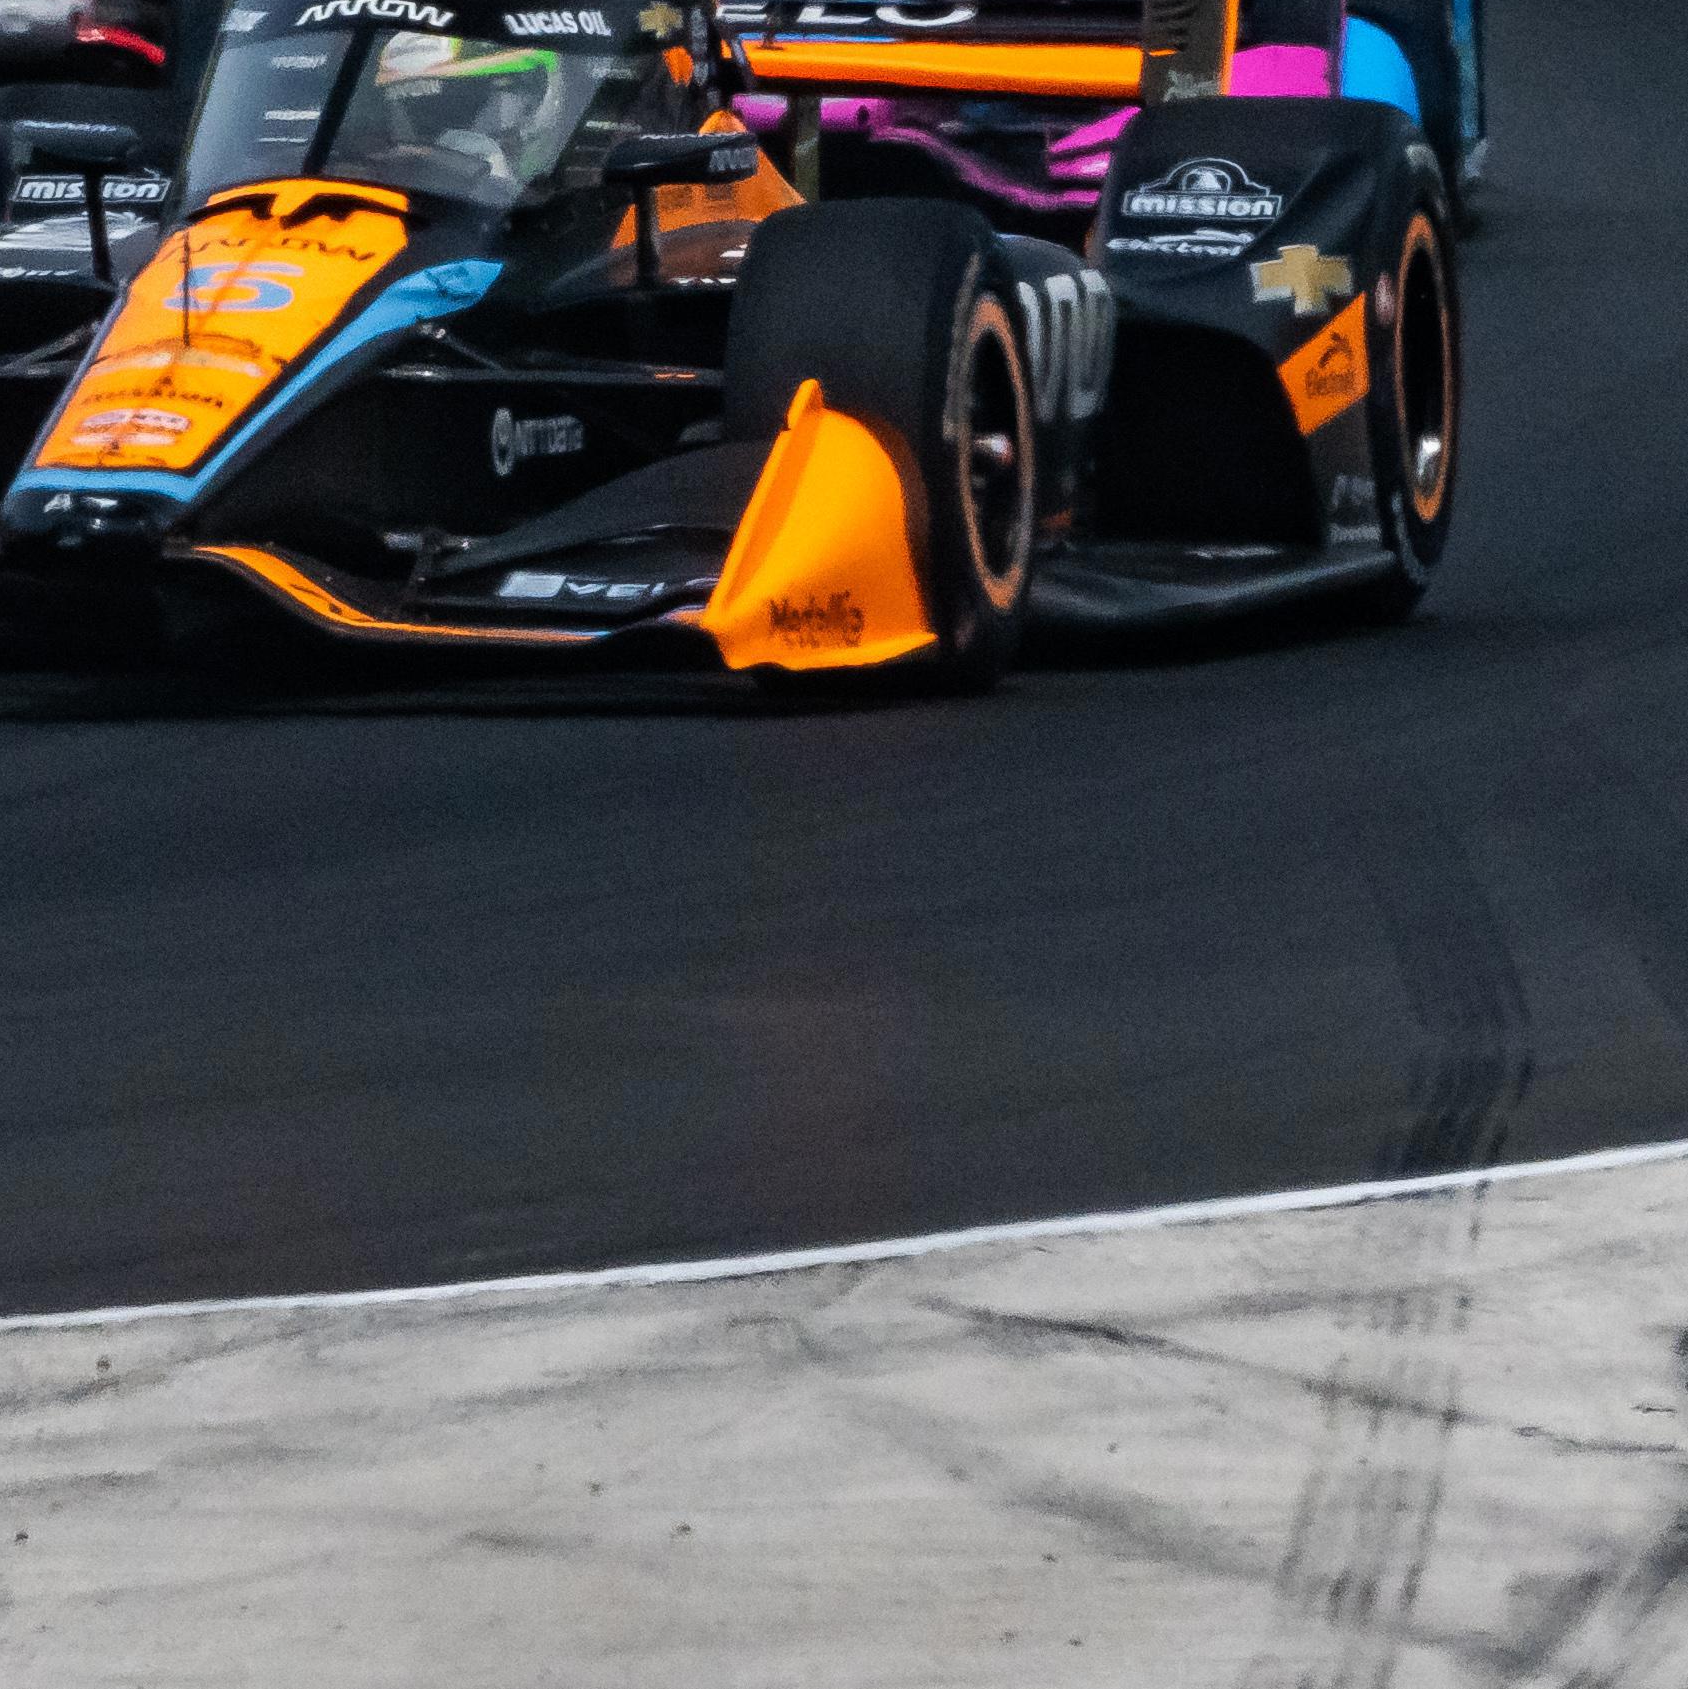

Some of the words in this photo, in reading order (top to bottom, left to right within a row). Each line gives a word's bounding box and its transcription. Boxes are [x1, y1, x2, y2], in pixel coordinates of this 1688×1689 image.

[505, 14, 579, 36] LUCAS
[579, 12, 613, 37] OIL
[20, 180, 164, 200] mision
[1129, 194, 1274, 216] mission
[163, 261, 305, 312] 5
